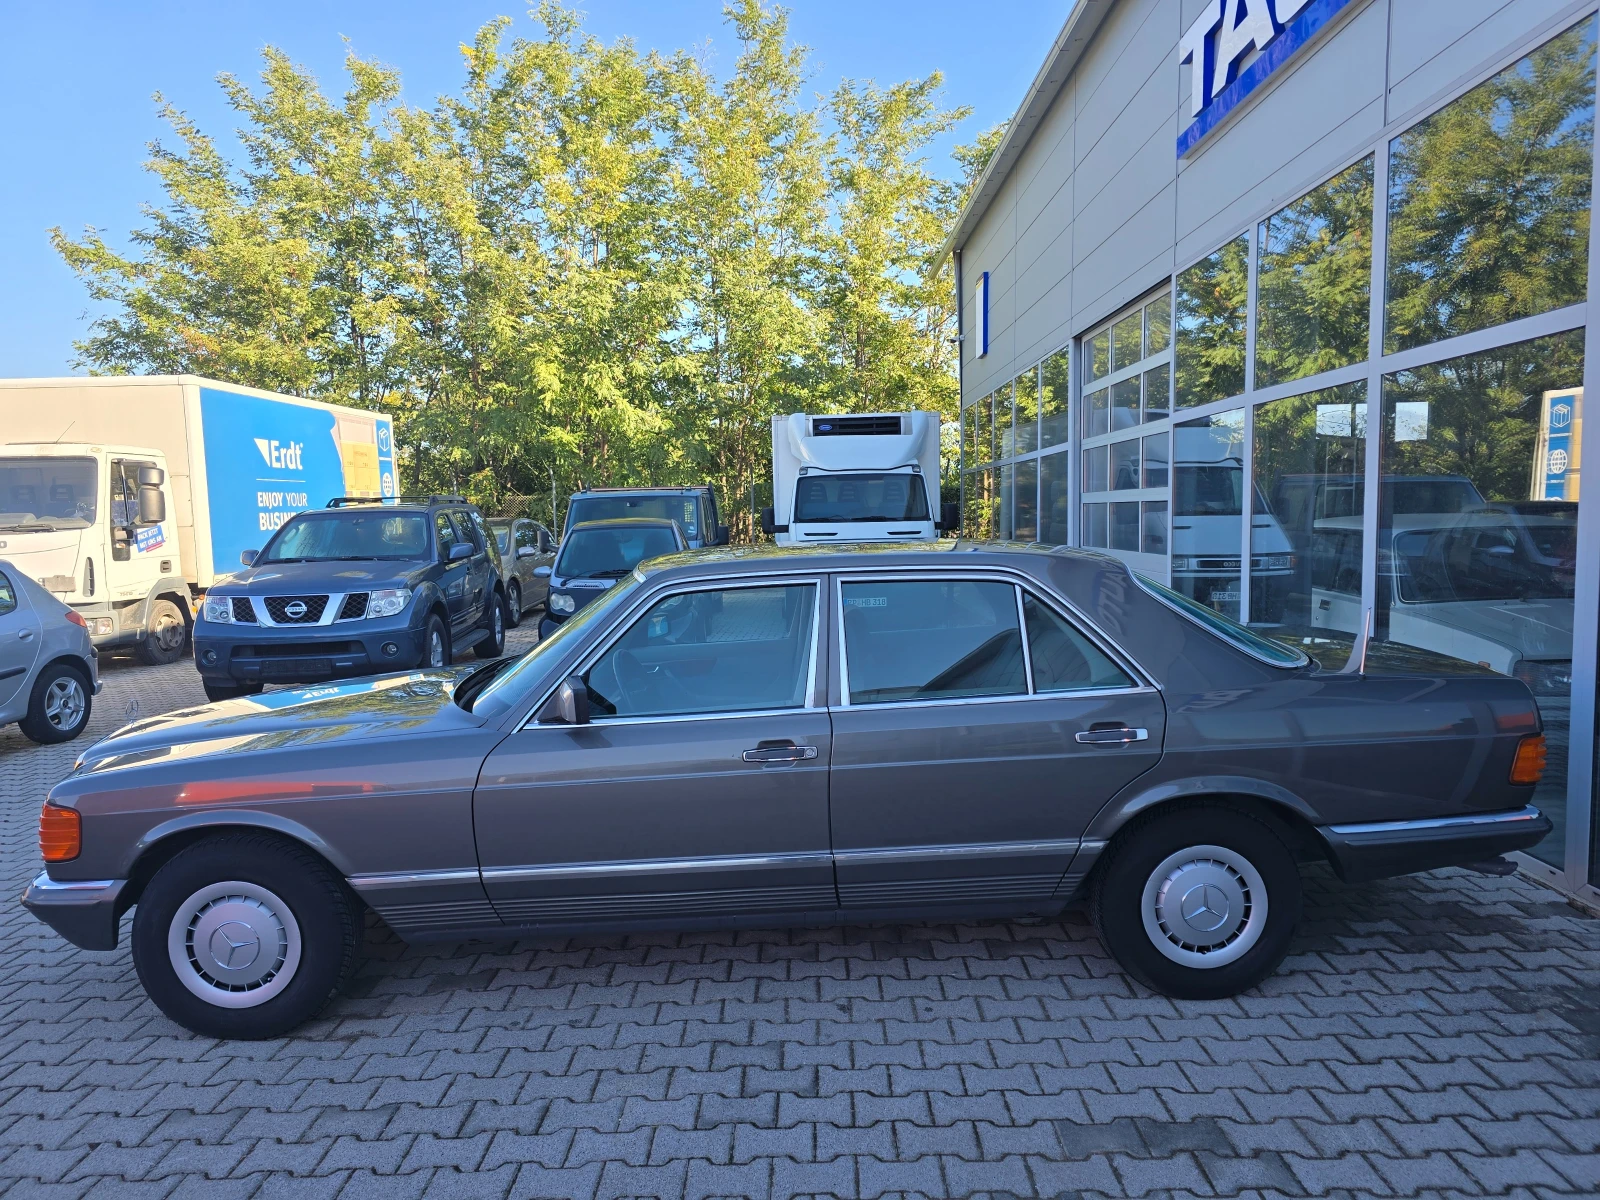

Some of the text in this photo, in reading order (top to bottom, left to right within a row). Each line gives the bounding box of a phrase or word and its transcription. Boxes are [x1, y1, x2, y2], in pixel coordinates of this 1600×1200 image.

[1180, 0, 1309, 118] TA
[270, 440, 303, 470] Erdt
[257, 492, 308, 509] ENJOY YOUR
[259, 511, 300, 531] BUSIN
[872, 598, 886, 606] 318
